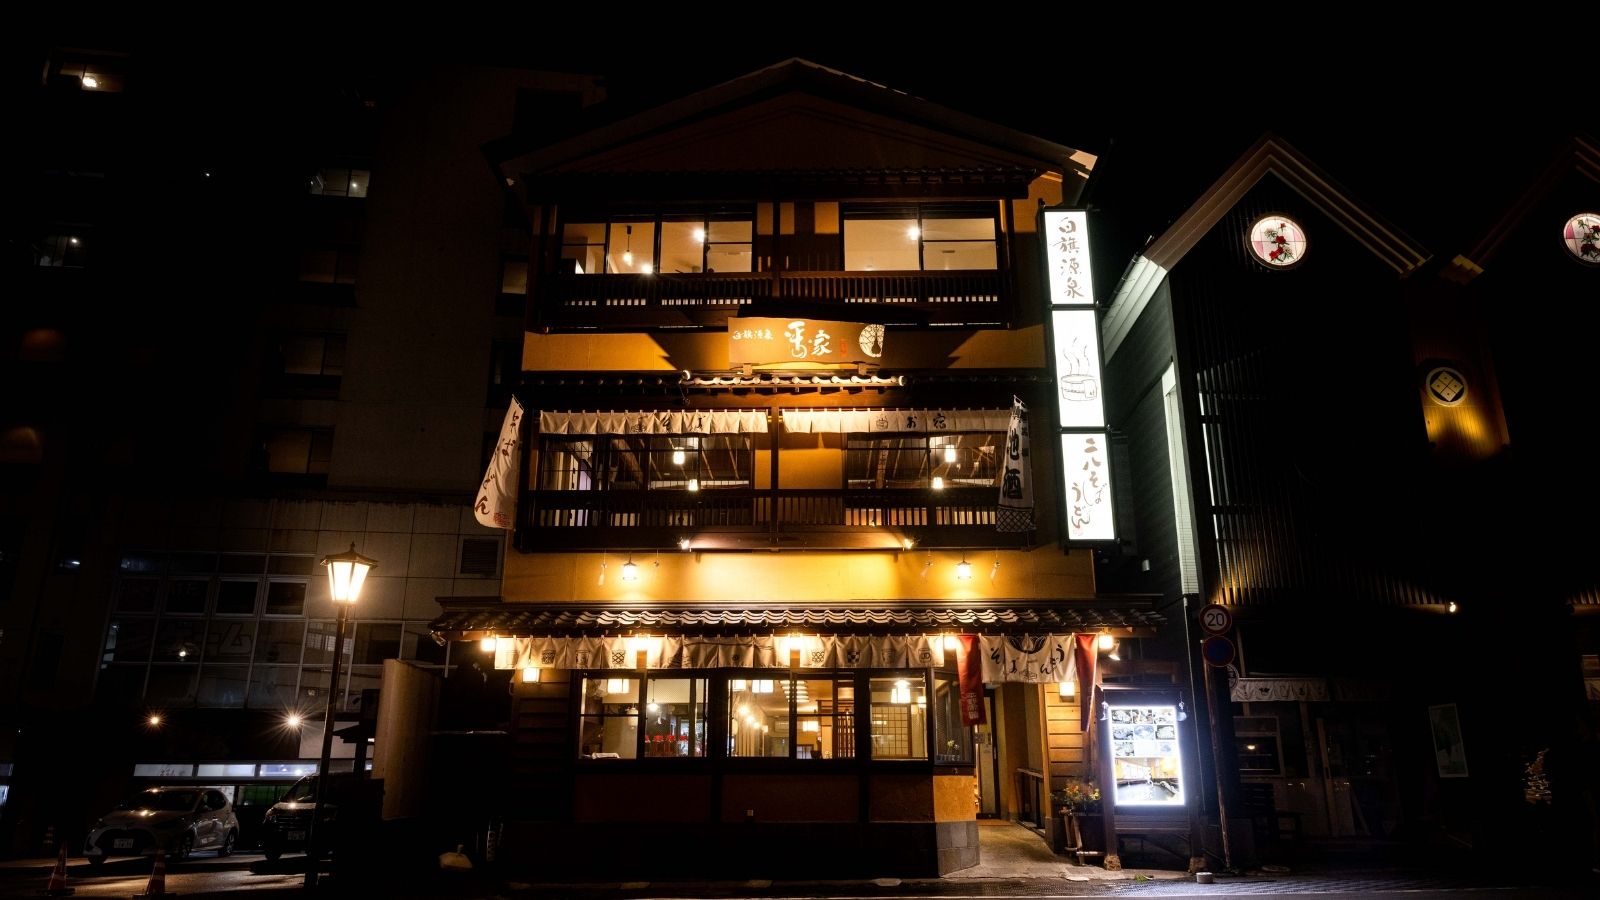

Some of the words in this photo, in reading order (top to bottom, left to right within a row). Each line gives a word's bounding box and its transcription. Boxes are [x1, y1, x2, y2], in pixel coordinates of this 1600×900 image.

[1053, 217, 1084, 298] 白旗源泉
[1071, 482, 1091, 529] うどん
[1207, 613, 1225, 626] 20
